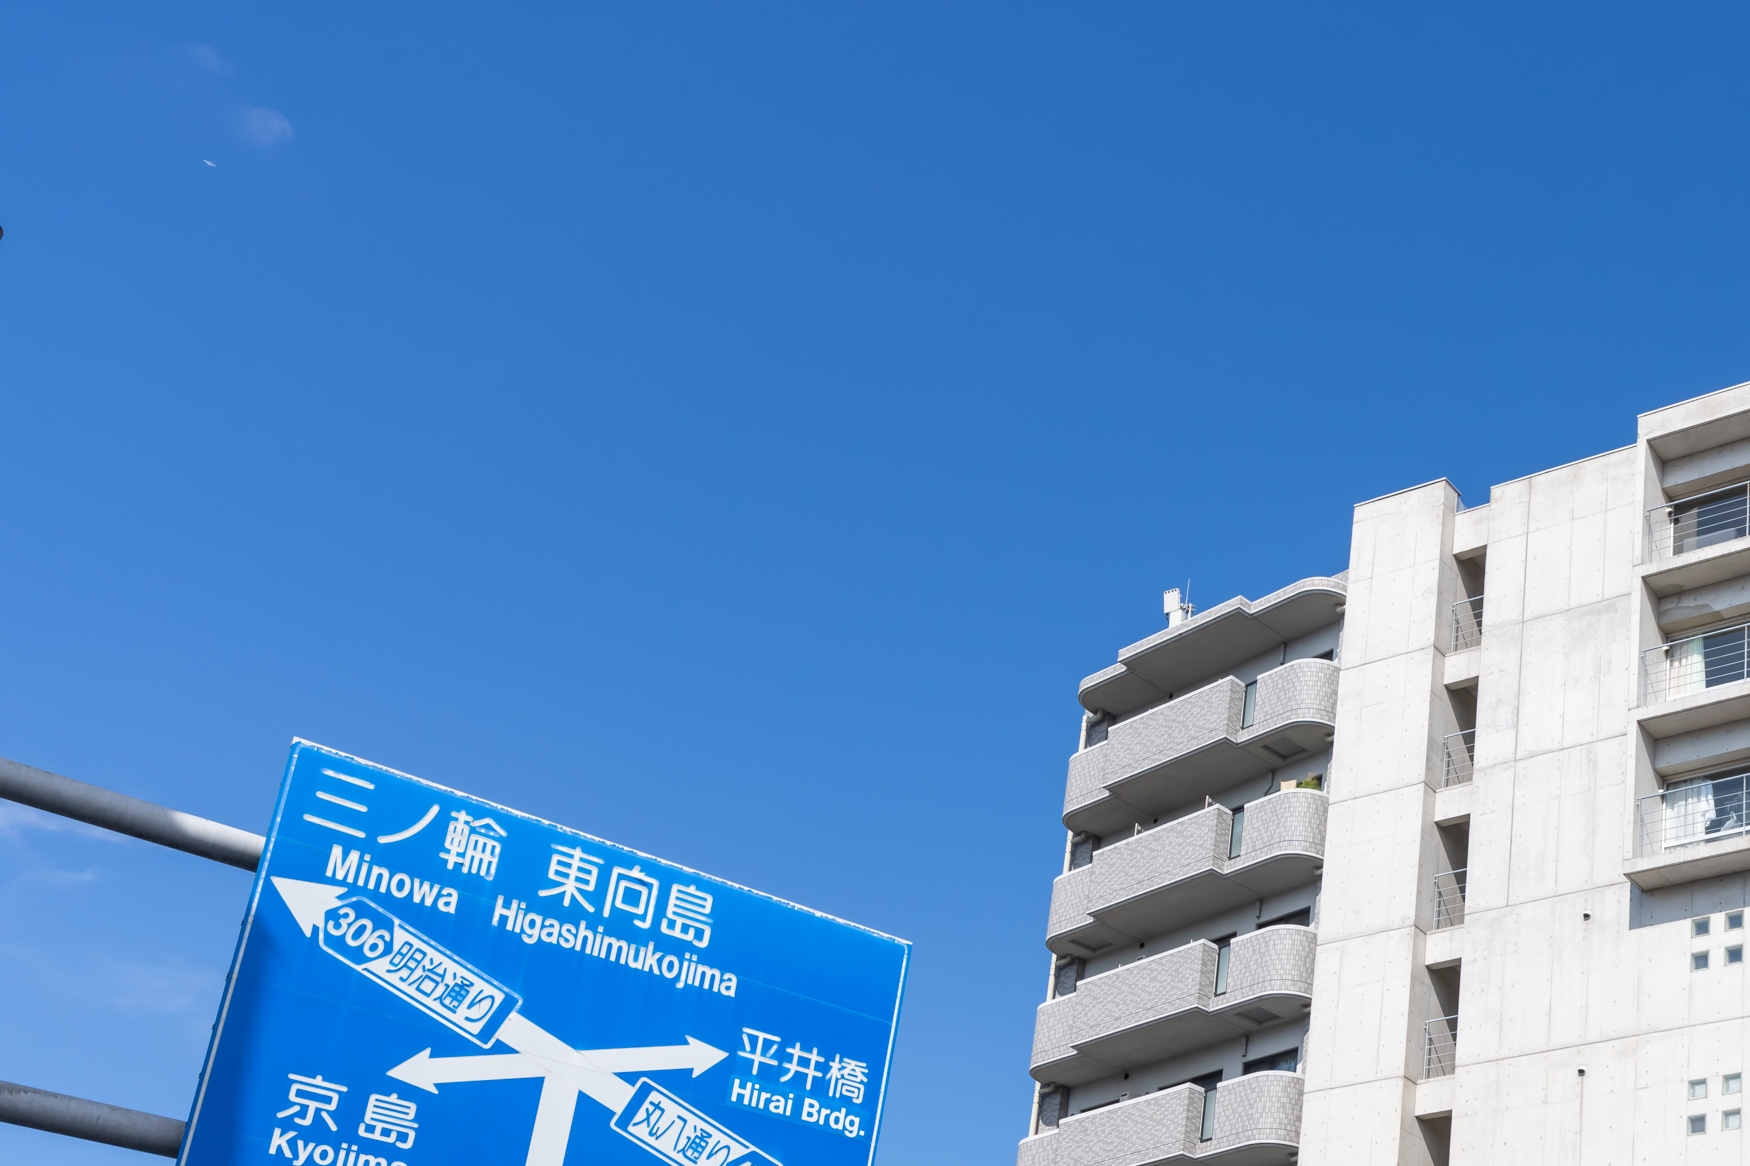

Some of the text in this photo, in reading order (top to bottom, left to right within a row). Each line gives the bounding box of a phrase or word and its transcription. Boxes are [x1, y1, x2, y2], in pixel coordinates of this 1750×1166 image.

[303, 768, 714, 949] 三ノ輪 東向島
[325, 844, 738, 997] Minowa Higashimukojima
[327, 907, 496, 1023] 306 明治通り
[276, 1073, 419, 1149] 京島
[731, 1078, 865, 1138] Hirai Brdg.
[737, 1027, 869, 1104] 平井橋
